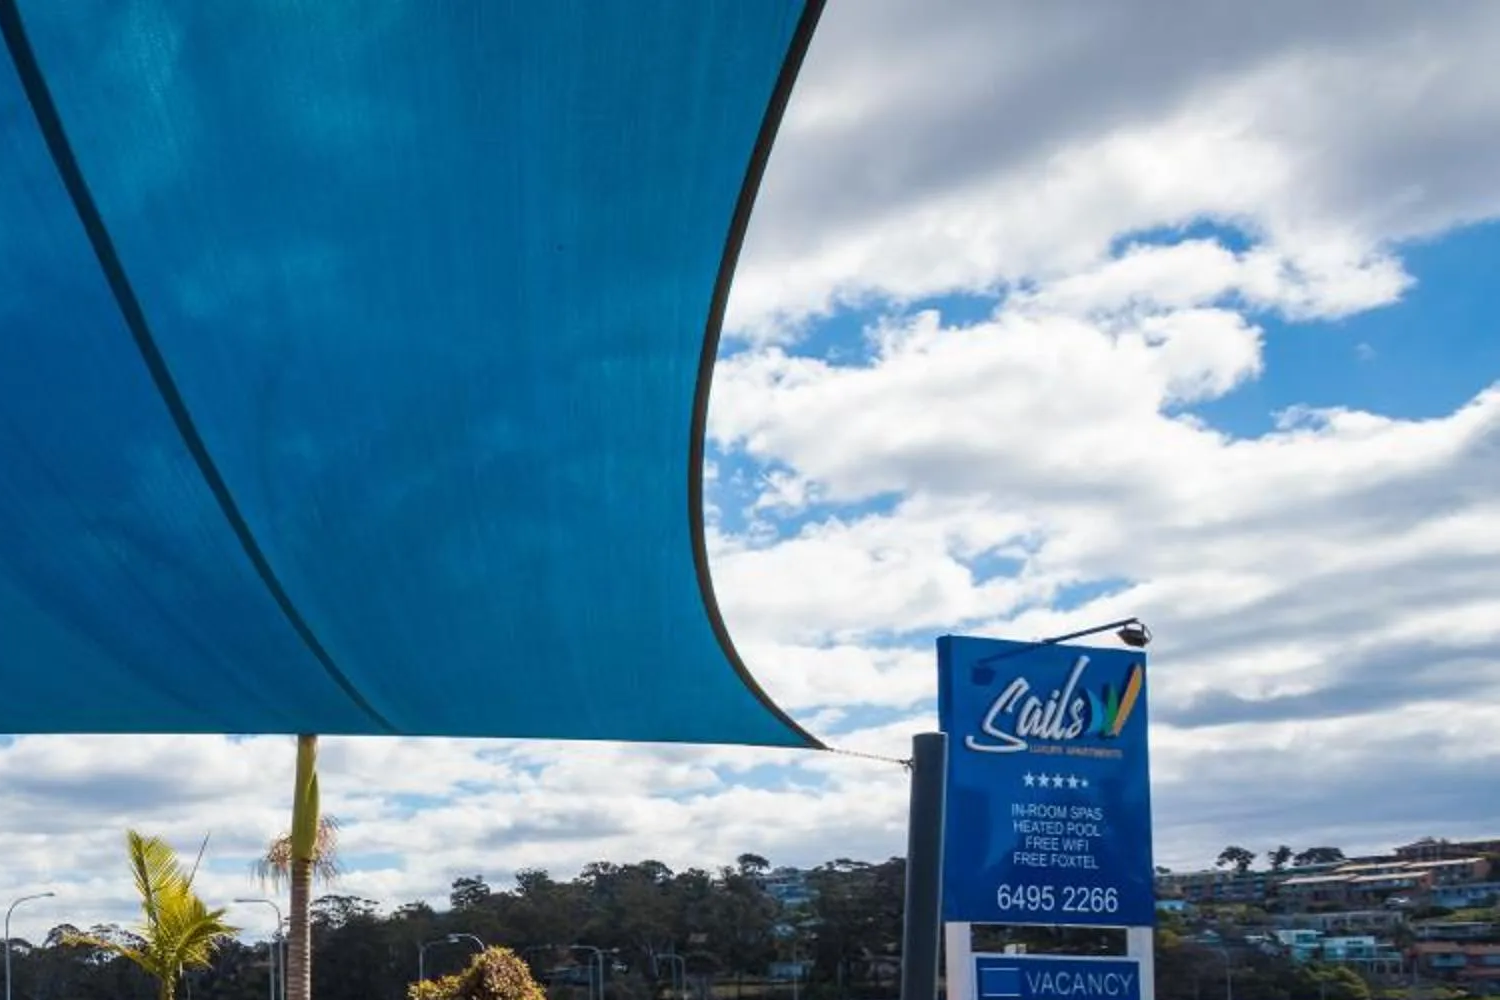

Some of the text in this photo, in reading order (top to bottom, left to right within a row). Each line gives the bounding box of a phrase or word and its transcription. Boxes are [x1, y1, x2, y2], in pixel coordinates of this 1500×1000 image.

[965, 655, 1090, 753] Sails
[1011, 803, 1104, 821] IN-ROOM SPAS
[1012, 819, 1102, 837] HEATED POOL
[1025, 835, 1060, 851] FREE
[1013, 851, 1100, 869] FREE FOXTEL
[997, 883, 1119, 913] 6495 2266
[1025, 971, 1134, 996] VACANCY
